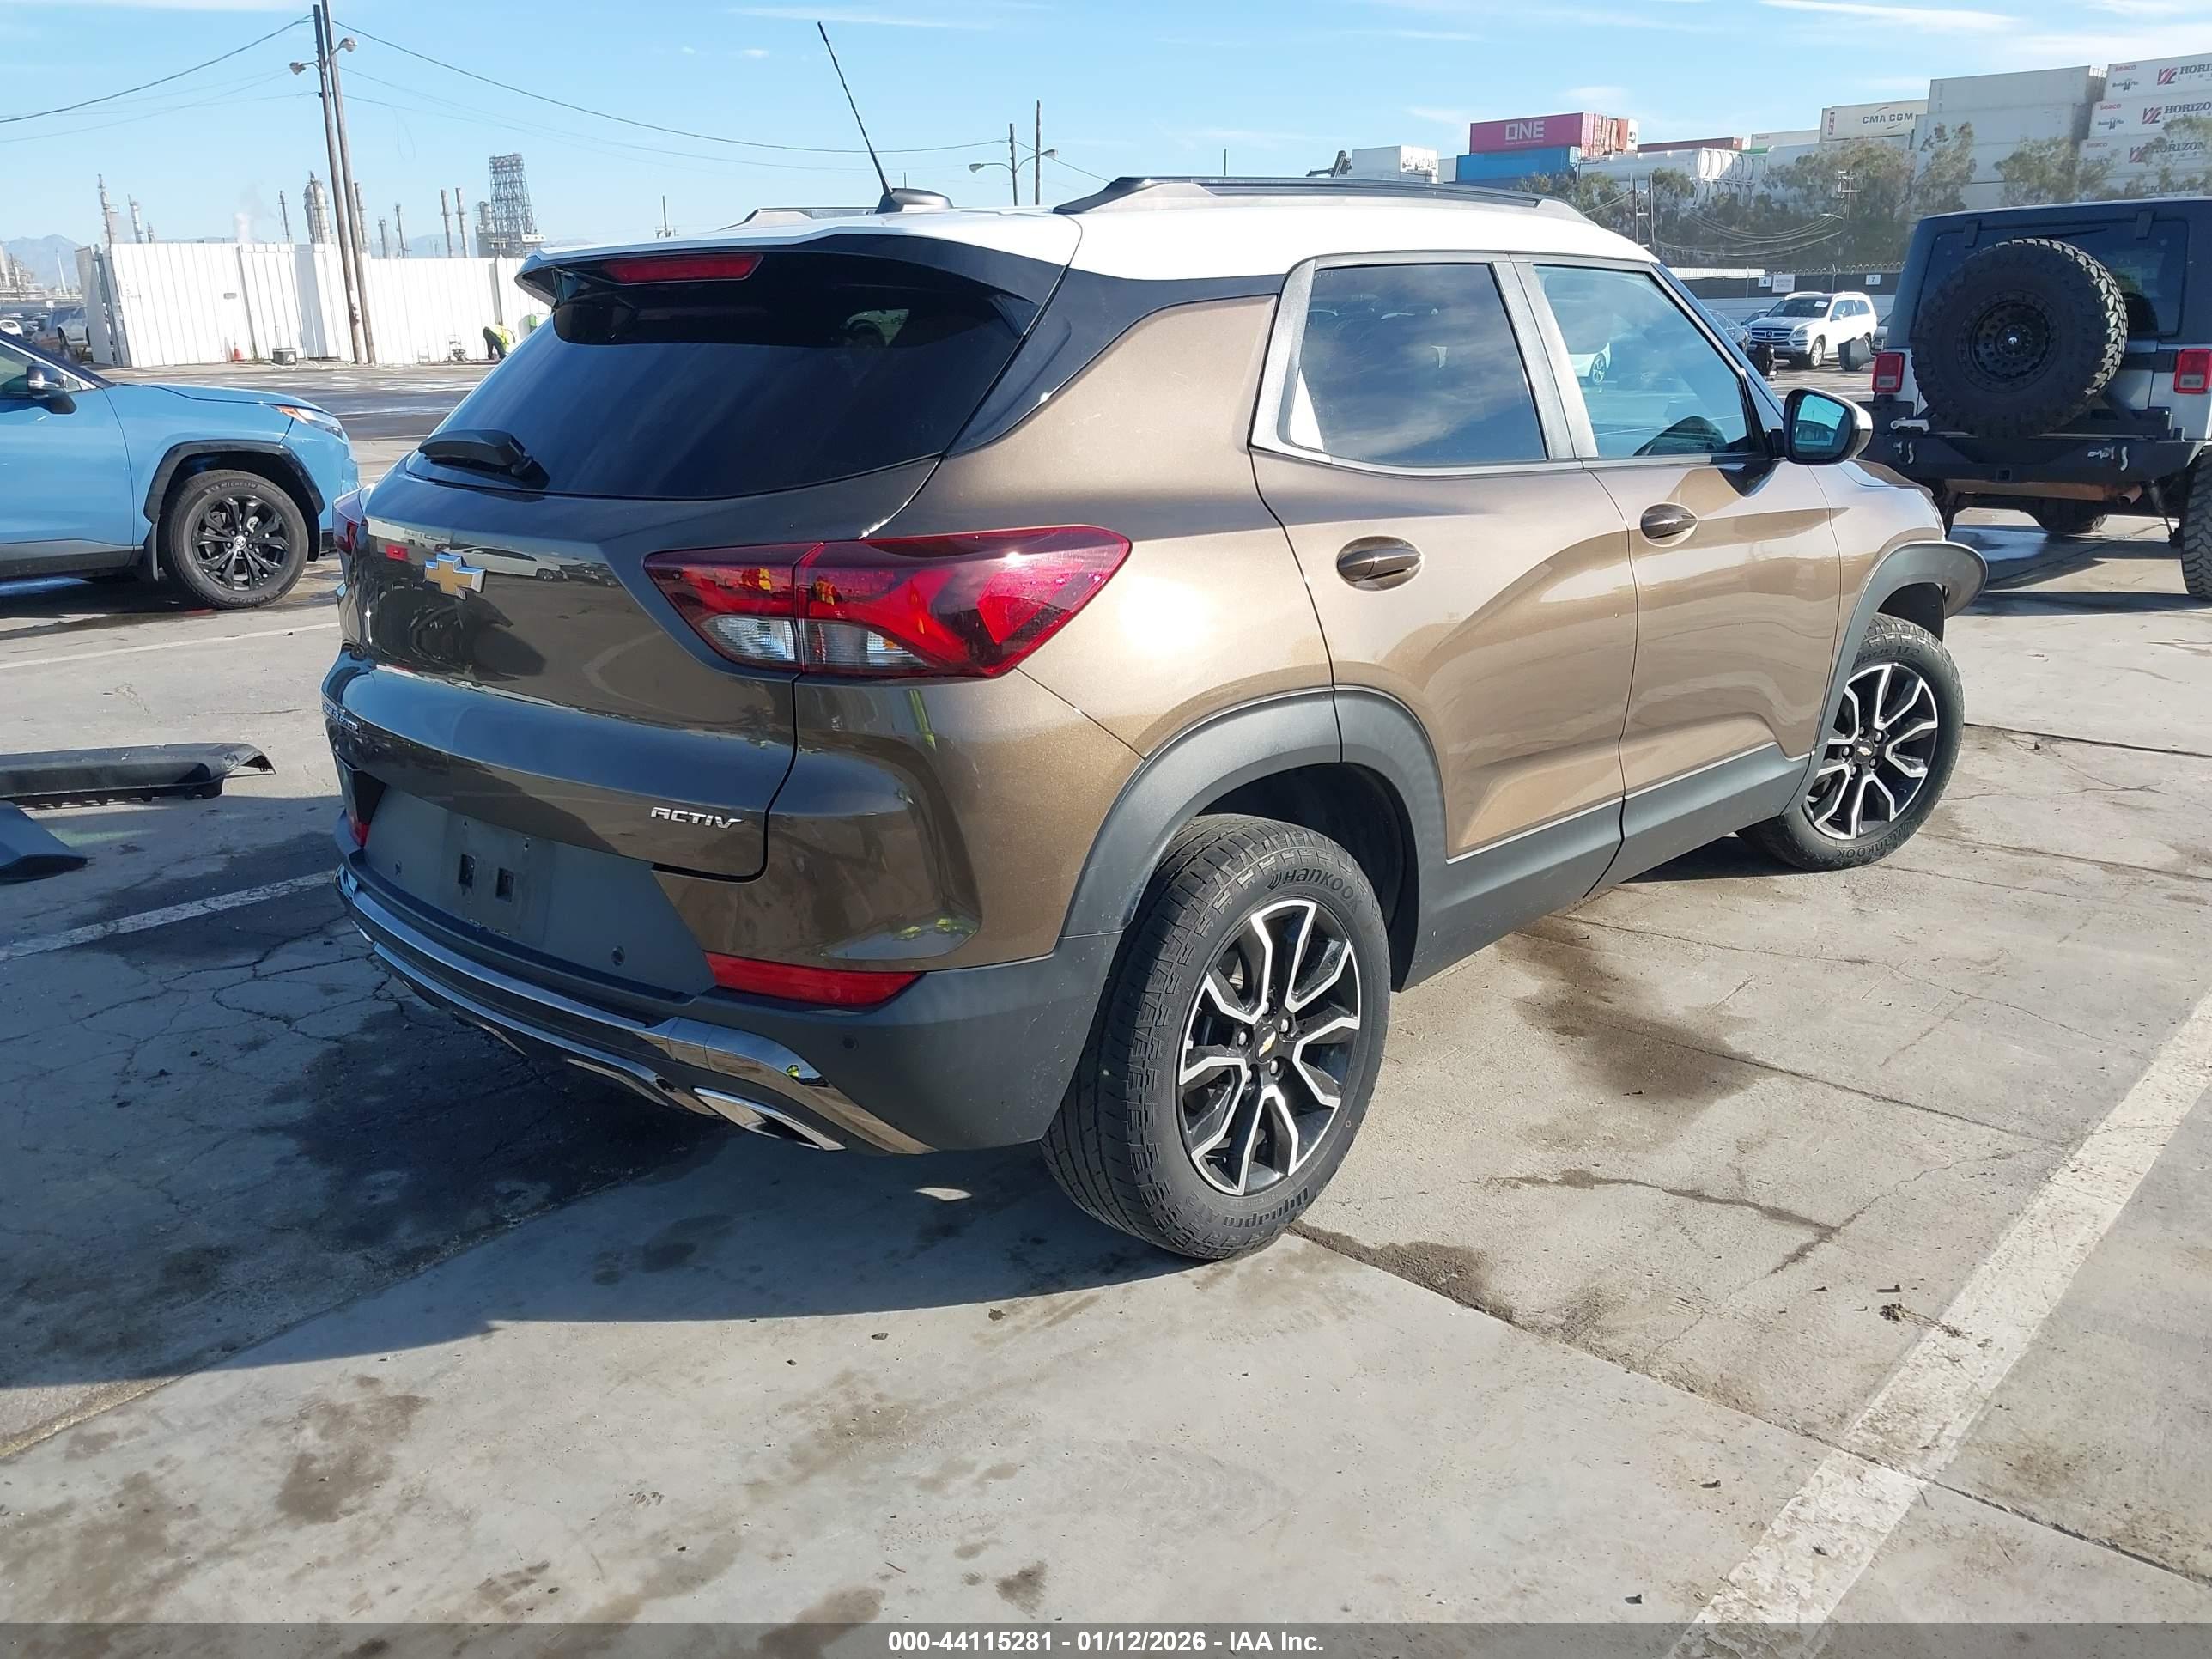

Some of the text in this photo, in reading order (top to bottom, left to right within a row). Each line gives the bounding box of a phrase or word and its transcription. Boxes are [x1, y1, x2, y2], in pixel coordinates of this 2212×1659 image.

[2179, 64, 2212, 75] HORI
[1862, 112, 1913, 124] CMA CGM
[1505, 120, 1545, 140] ONE
[650, 806, 745, 830] ACTIV
